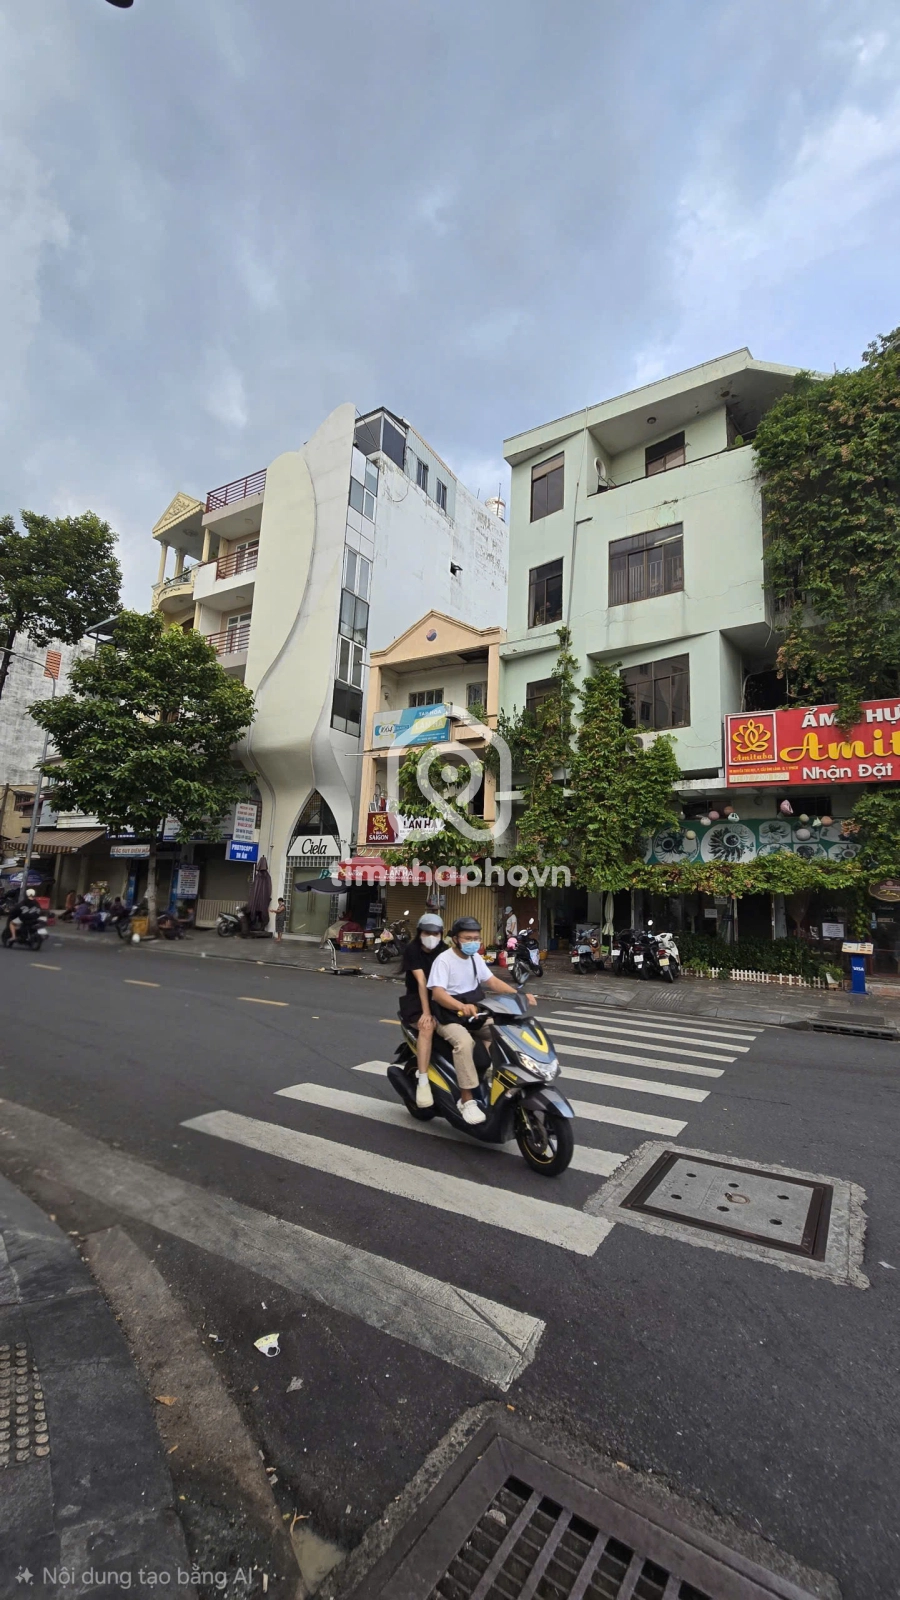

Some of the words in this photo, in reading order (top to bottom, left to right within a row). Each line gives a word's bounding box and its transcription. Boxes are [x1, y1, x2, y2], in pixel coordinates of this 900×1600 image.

[801, 707, 838, 728] ẨM
[802, 764, 852, 782] Nhận
[858, 762, 893, 779] Đặt
[301, 838, 328, 855] Ciela
